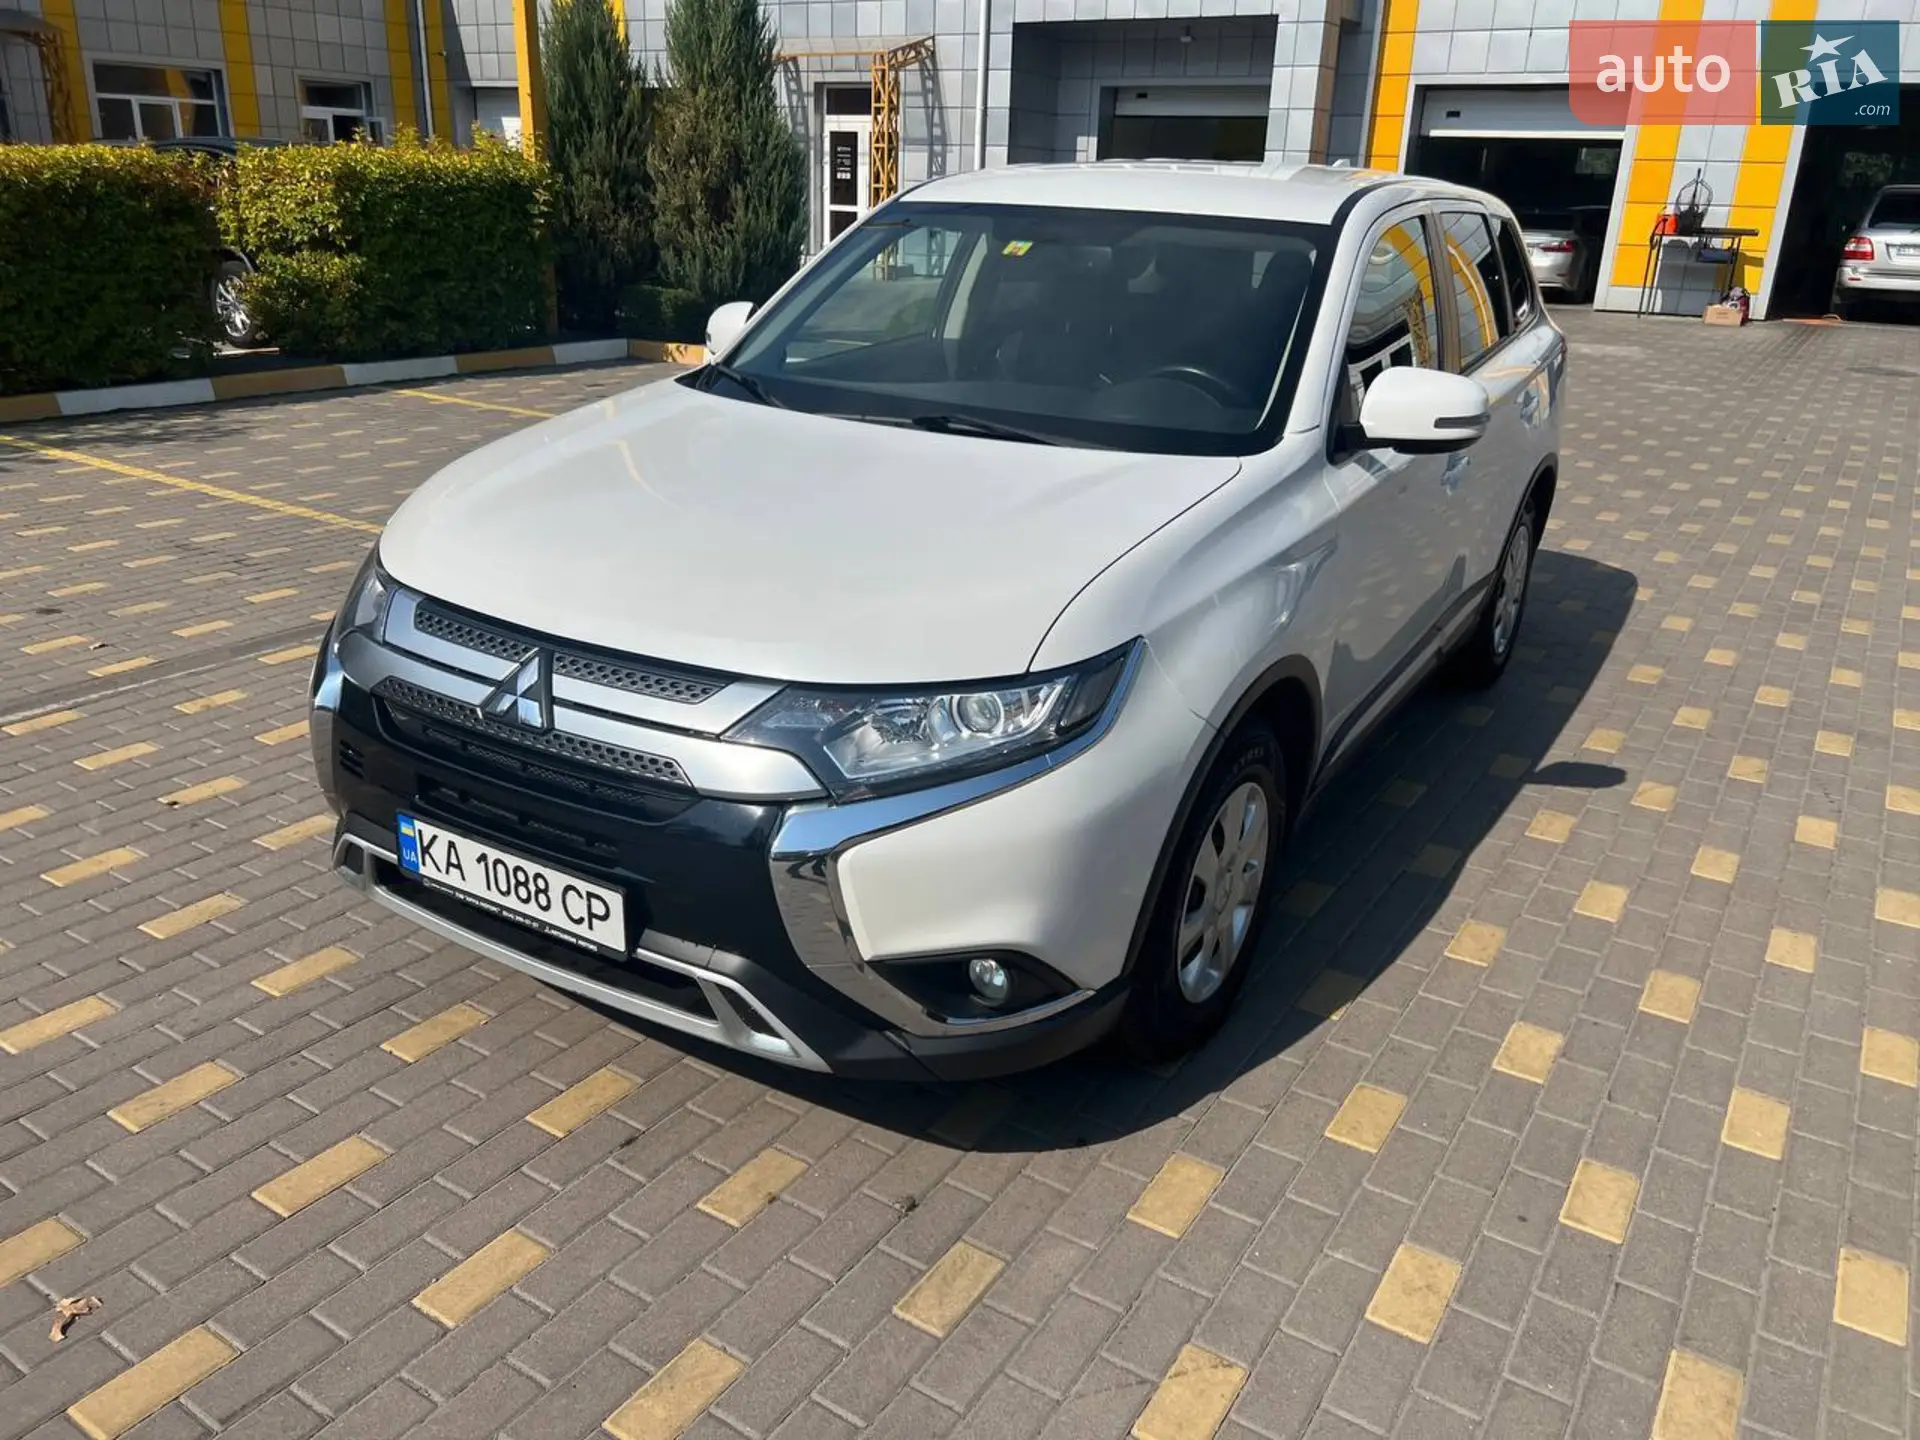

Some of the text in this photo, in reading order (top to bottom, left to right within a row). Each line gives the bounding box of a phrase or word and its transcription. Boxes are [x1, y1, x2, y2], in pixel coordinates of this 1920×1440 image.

[403, 849, 417, 863] UA
[418, 828, 466, 881] KA
[476, 852, 551, 912] 1088
[561, 884, 611, 931] CP
